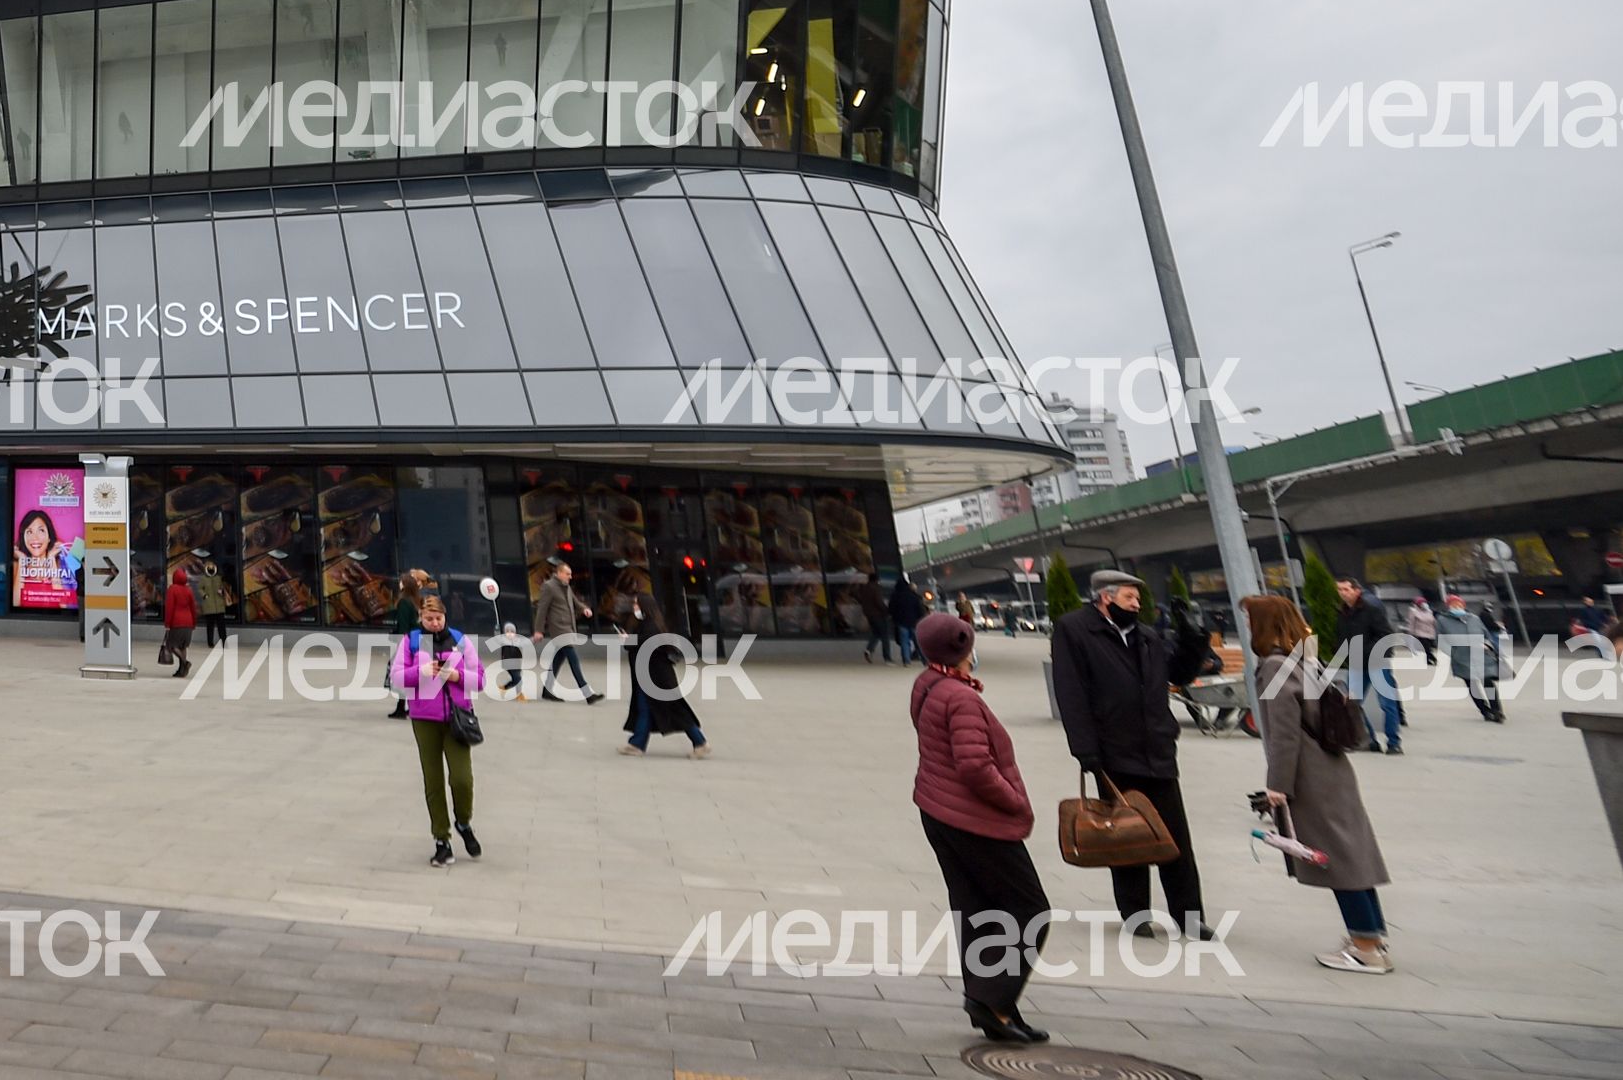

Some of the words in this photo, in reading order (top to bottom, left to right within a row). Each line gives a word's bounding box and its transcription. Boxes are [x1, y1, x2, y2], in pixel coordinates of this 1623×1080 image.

[235, 292, 466, 335] SPENCER
[20, 558, 54, 568] ВРЕМЯ
[20, 567, 71, 578] ШОПИНГА!
